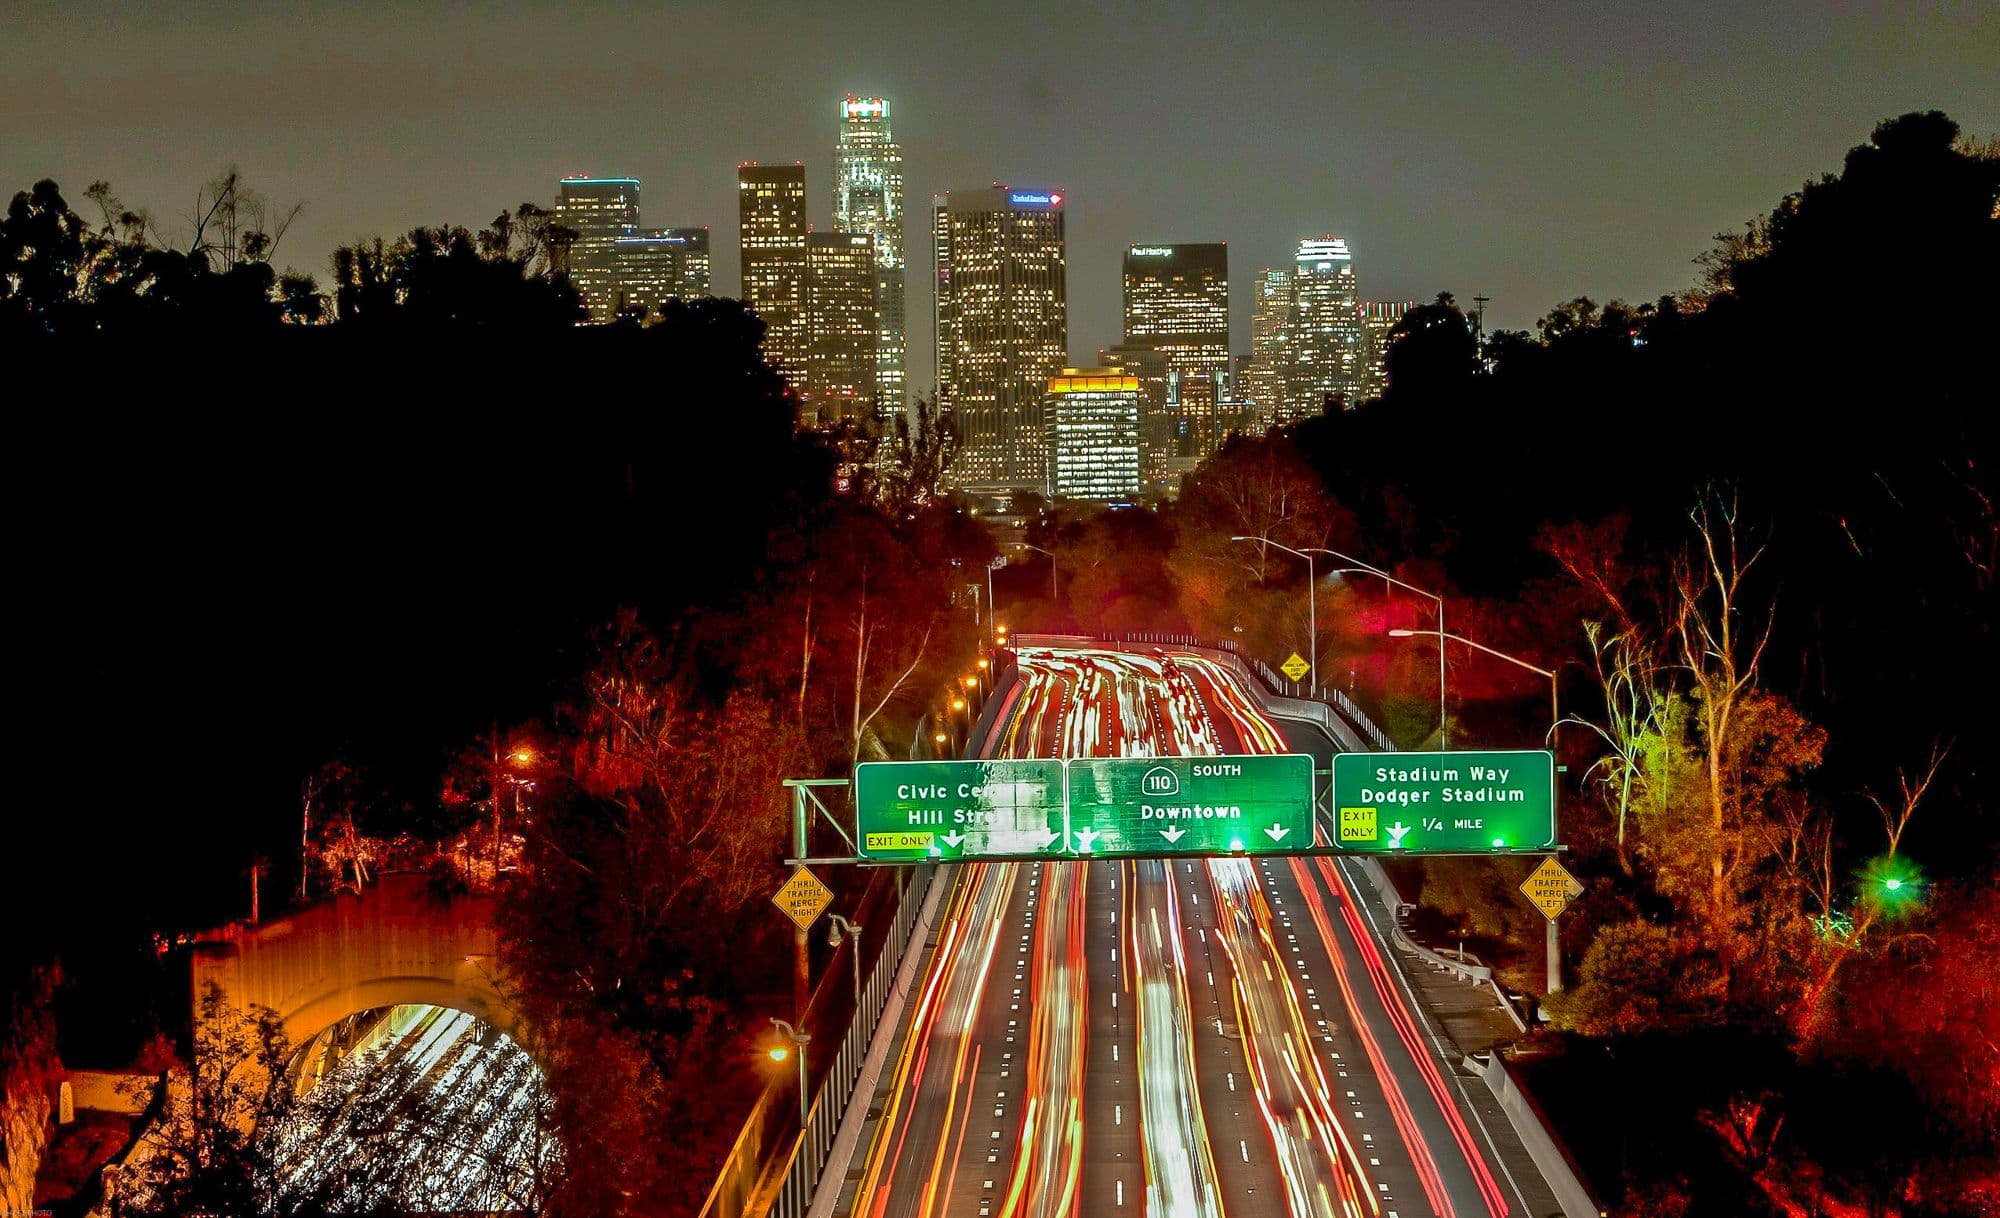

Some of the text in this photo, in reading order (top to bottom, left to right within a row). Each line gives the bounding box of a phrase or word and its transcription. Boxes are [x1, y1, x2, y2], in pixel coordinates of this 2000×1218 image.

[1193, 765, 1241, 777] SOUTH
[1376, 766, 1510, 784] Stadium Way
[1150, 776, 1171, 790] 110
[897, 784, 947, 799] Civic
[1361, 788, 1525, 807] Dodger Stadium
[1141, 804, 1241, 819] Downtown
[908, 810, 943, 825] Hill
[1343, 812, 1374, 821] EXIT
[1422, 817, 1483, 831] 1/4 MILE
[1343, 828, 1374, 837] ONLY
[868, 836, 931, 846] EXIT ONLY
[1541, 869, 1562, 877] THRU
[792, 880, 815, 888] THRU
[1533, 879, 1569, 887] TRAFFIC
[786, 889, 822, 898] TRAFFIC
[1535, 890, 1568, 898] MERGE
[790, 899, 818, 908] MERGE
[1540, 900, 1563, 908] LEFT
[793, 908, 817, 917] RIGHT
